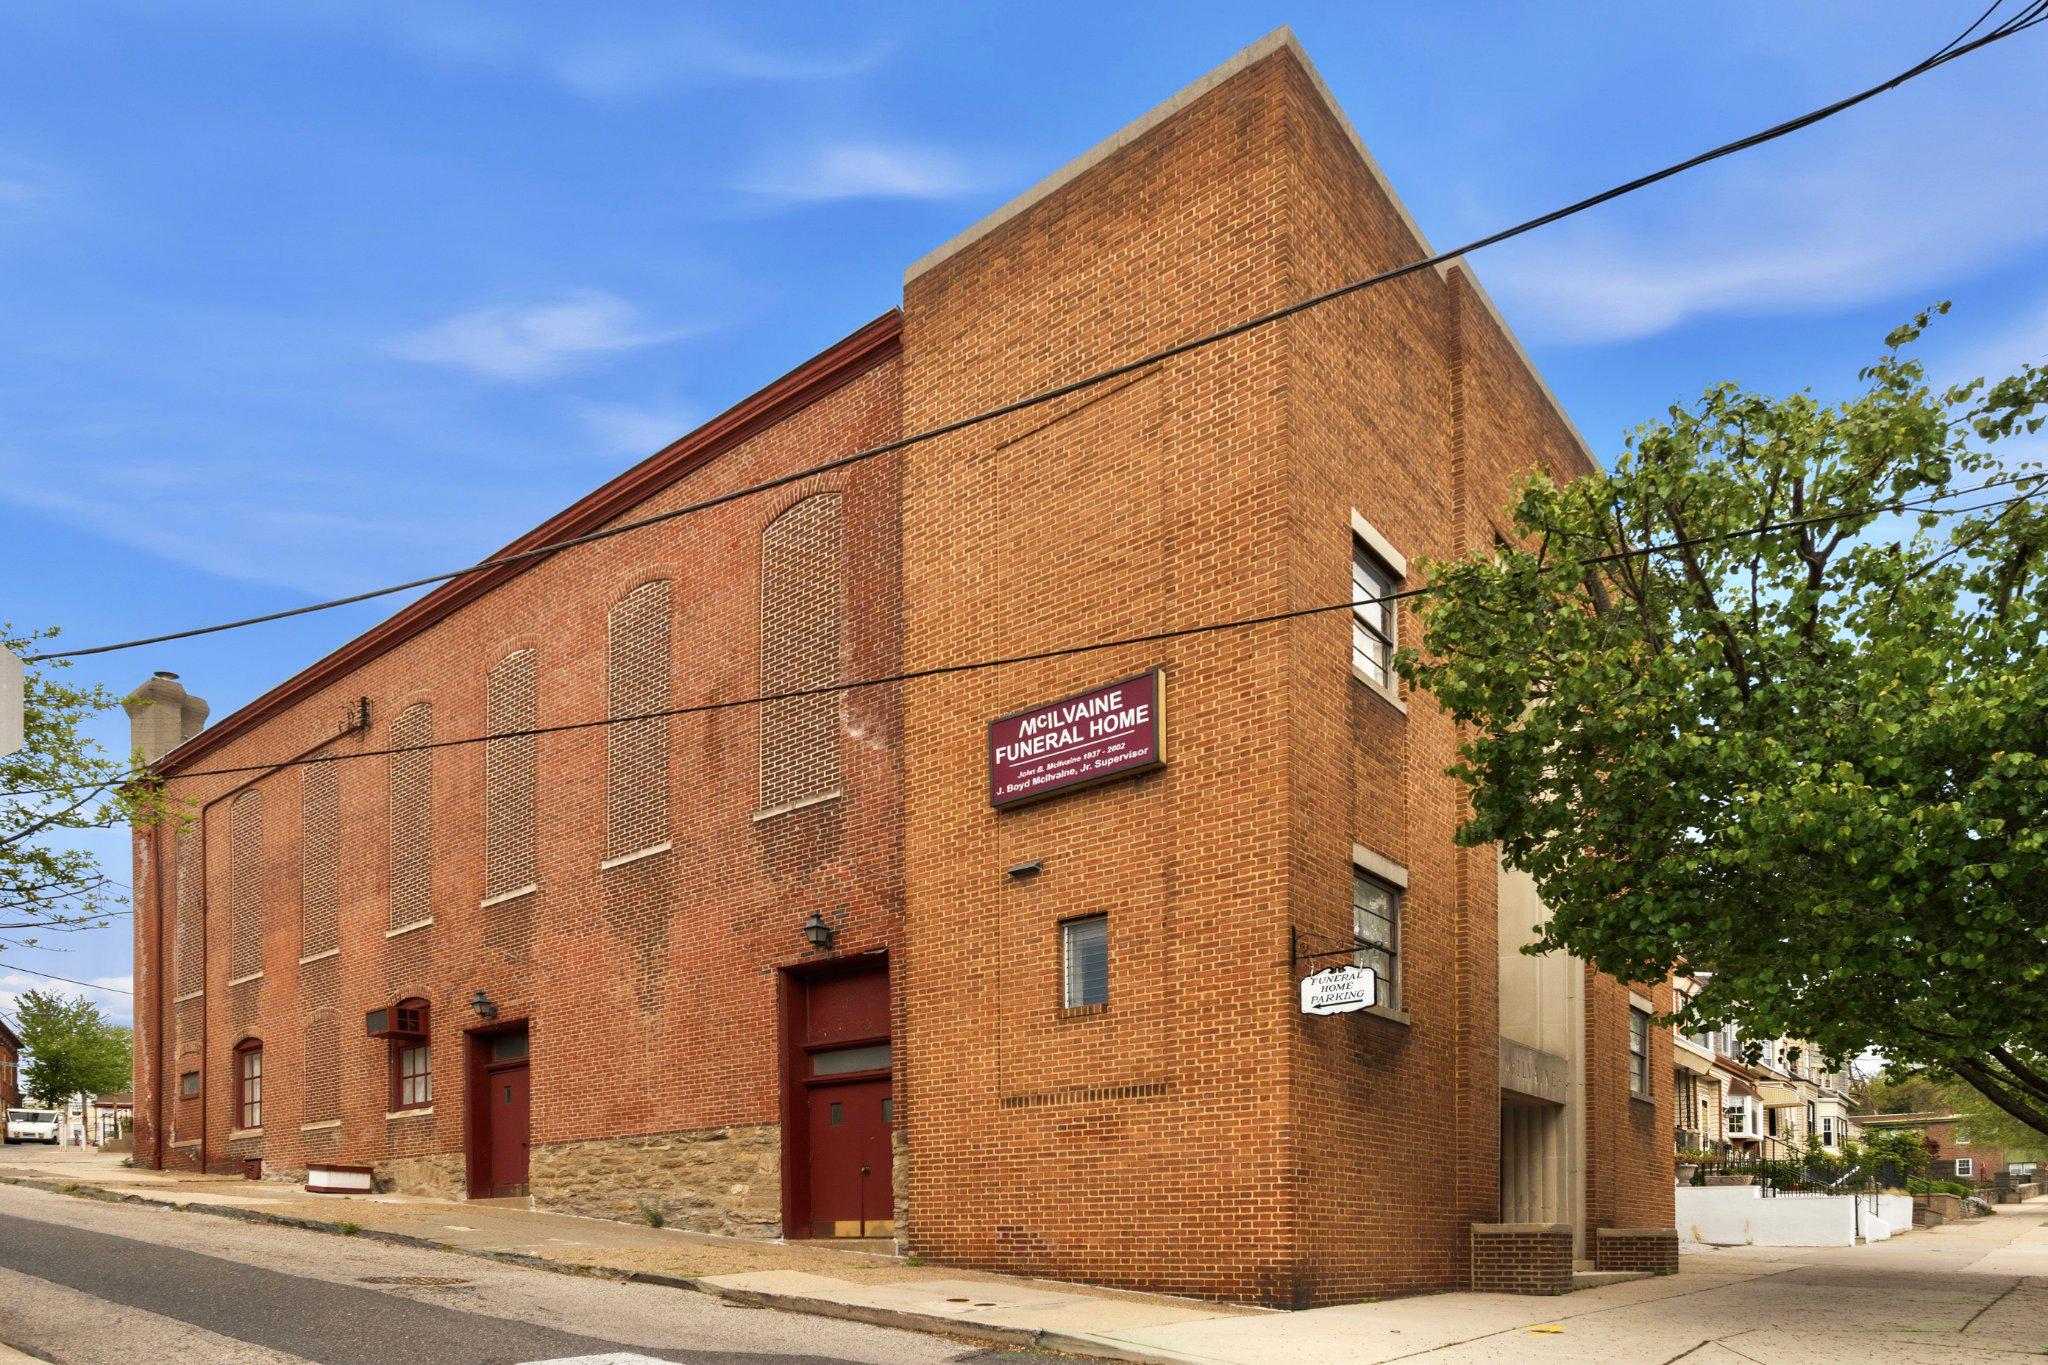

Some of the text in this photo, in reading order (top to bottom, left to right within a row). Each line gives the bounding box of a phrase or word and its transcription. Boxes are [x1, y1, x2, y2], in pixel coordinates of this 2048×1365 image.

[995, 704, 1149, 764] FUNERAL HOME
[996, 747, 1149, 795] J. Boyd McIlvaine, Jr. Supervisor
[1017, 769, 1036, 778] John
[1083, 749, 1101, 759] 1937
[1311, 972, 1364, 986] FUNERAL
[1321, 982, 1354, 993] HOME
[1310, 990, 1364, 1004] PARKING
